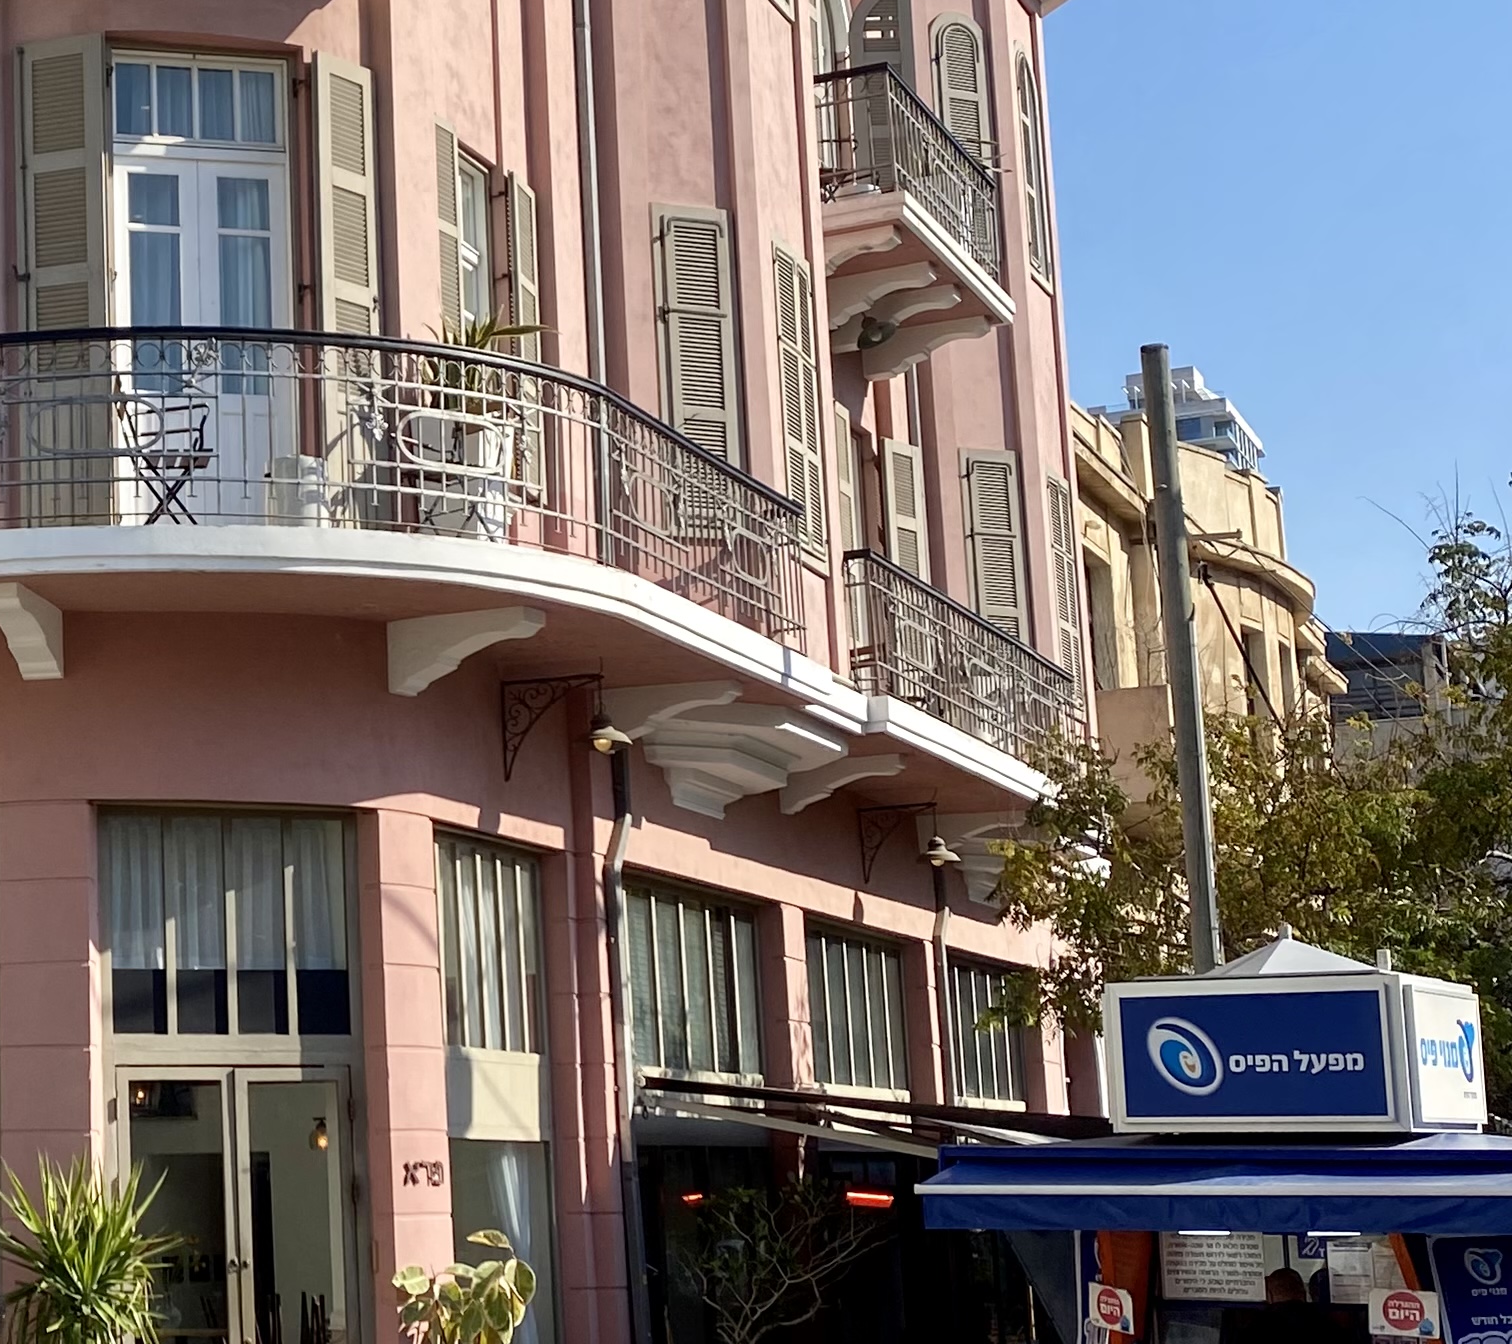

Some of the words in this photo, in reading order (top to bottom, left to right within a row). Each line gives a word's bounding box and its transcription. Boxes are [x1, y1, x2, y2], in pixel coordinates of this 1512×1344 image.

[1420, 1038, 1438, 1066] פיס
[1229, 1052, 1288, 1073] הפיס
[1294, 1049, 1364, 1075] מפעל
[1100, 1305, 1121, 1317] היום
[1389, 1308, 1421, 1321] היום
[1471, 1316, 1499, 1326] חודש
